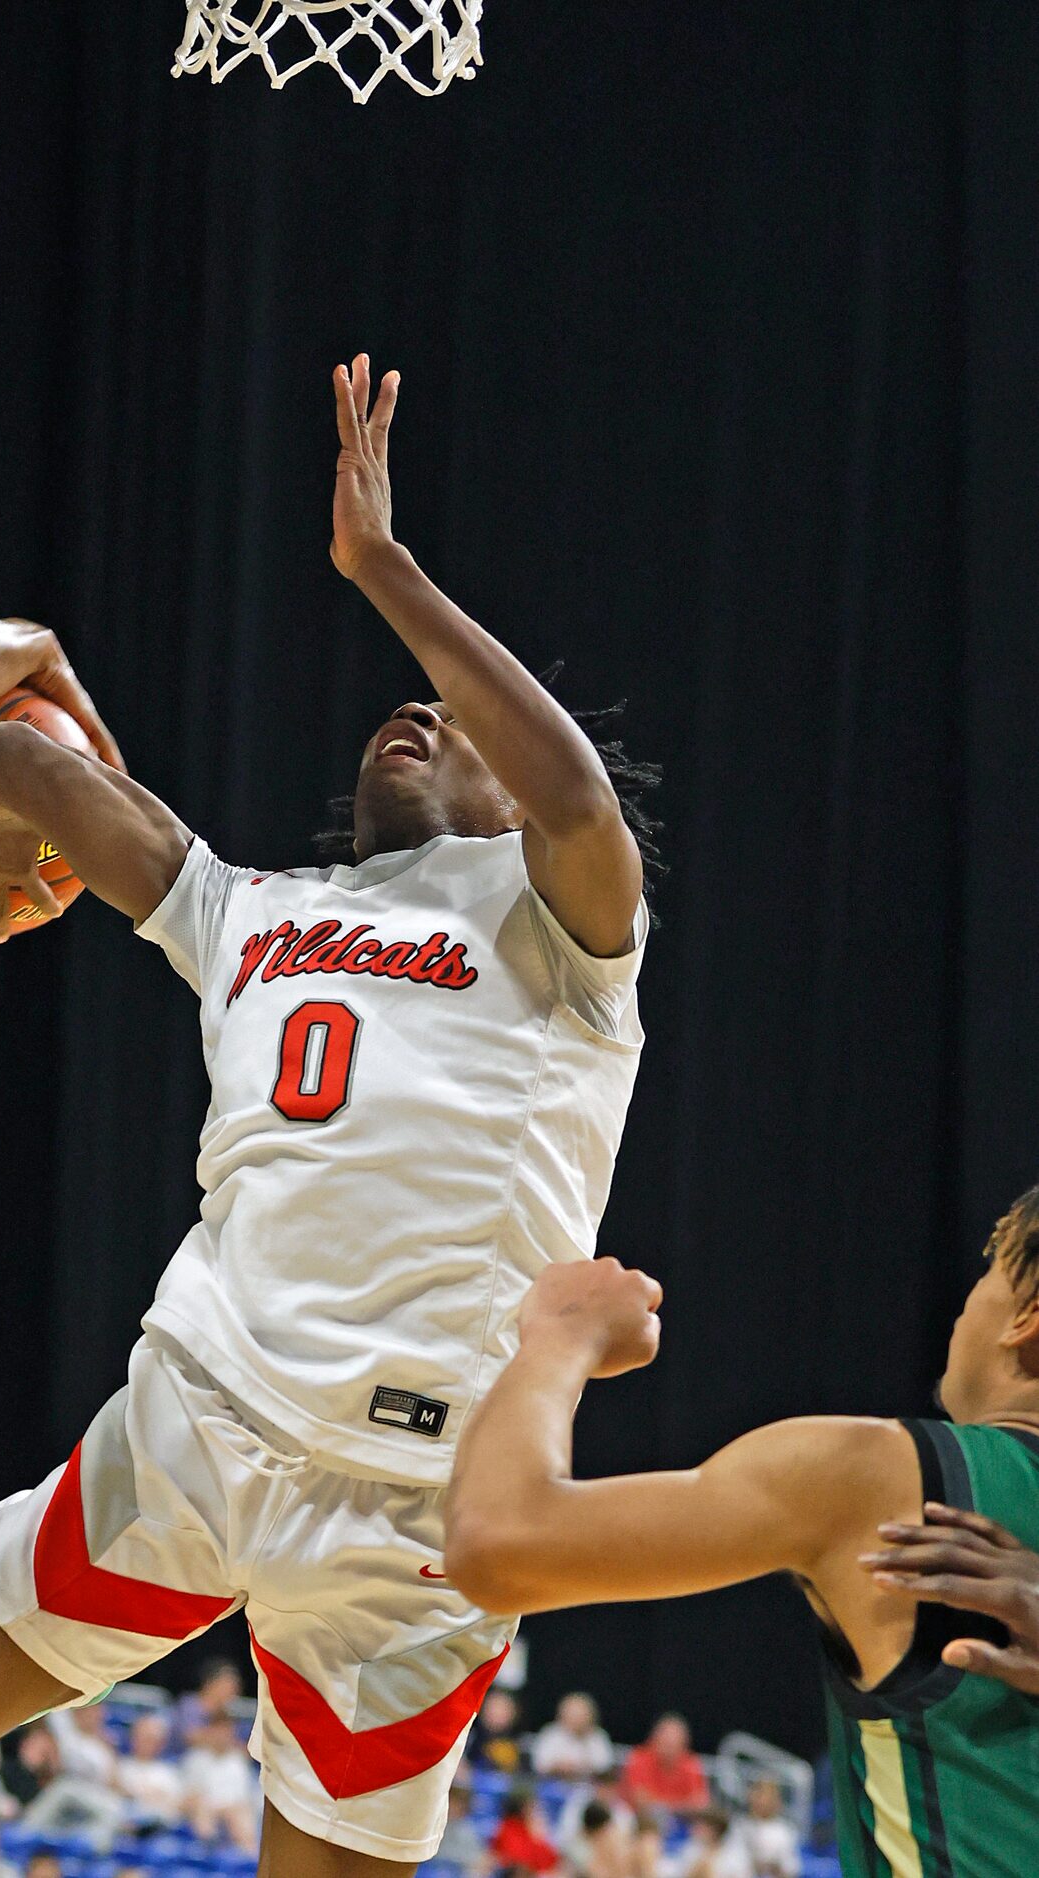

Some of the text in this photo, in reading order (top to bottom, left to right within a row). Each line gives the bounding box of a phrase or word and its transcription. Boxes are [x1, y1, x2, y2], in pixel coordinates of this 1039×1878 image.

[227, 919, 478, 1009] Wildcats
[266, 998, 364, 1123] 0
[420, 1409, 436, 1426] M
